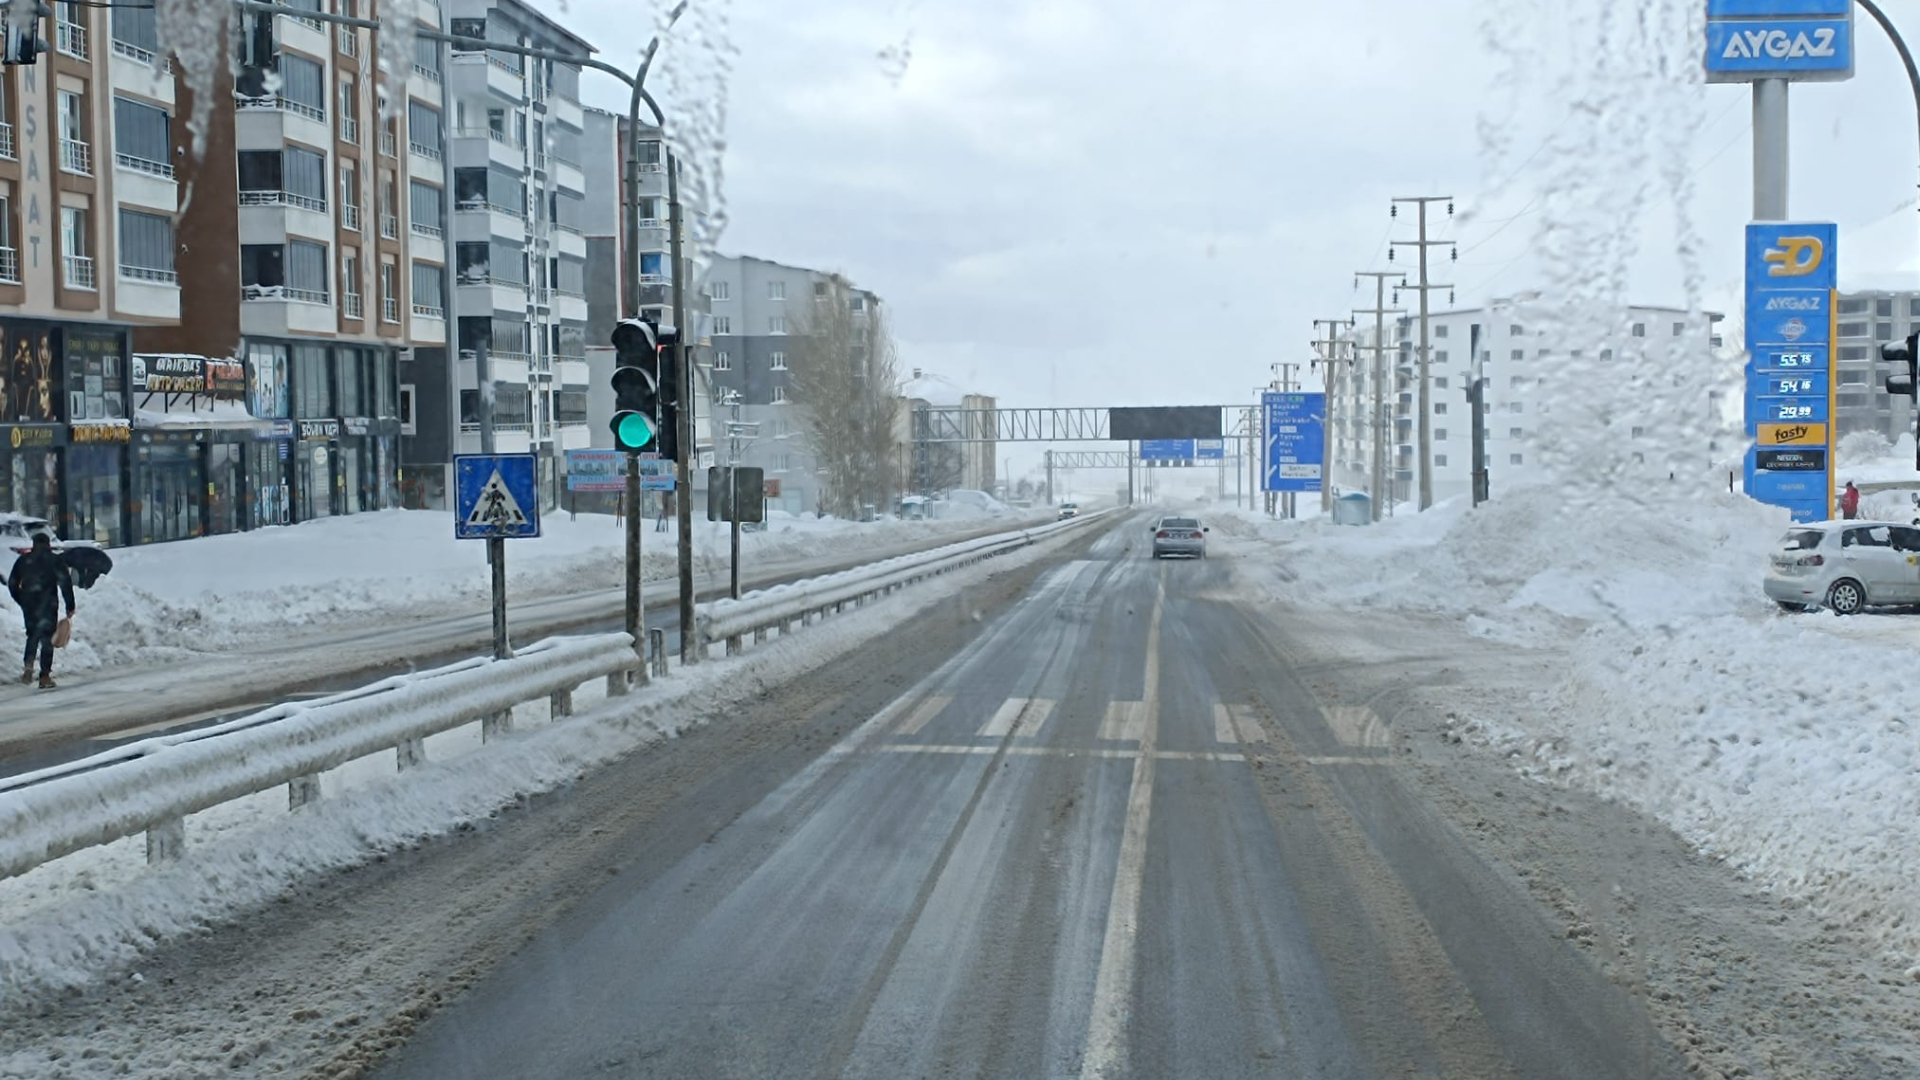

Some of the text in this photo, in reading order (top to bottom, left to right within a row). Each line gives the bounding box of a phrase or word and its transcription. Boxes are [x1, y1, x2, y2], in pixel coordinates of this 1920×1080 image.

[1722, 28, 1836, 60] AYGAZ
[24, 65, 41, 268] NŞAAT
[1765, 297, 1820, 310] AYGAZ
[1775, 425, 1808, 441] fasty
